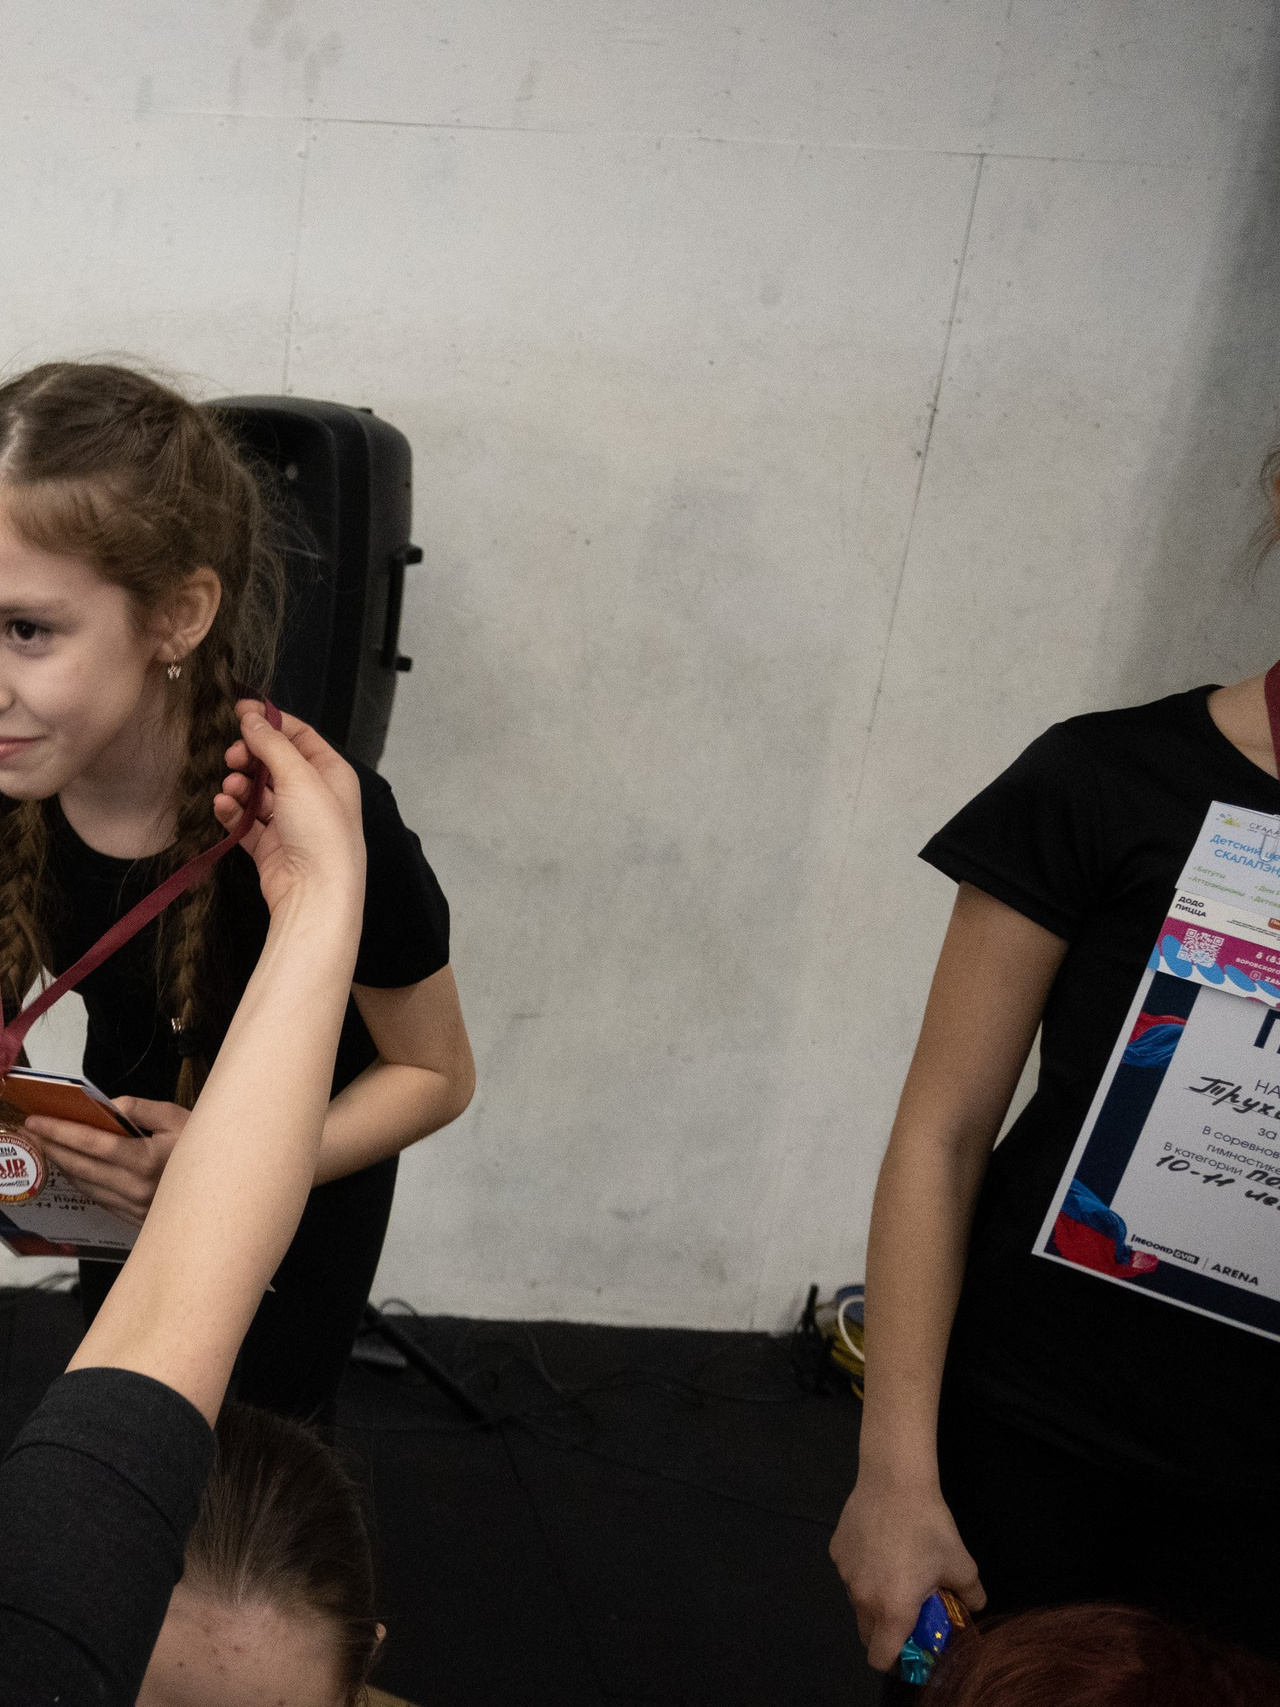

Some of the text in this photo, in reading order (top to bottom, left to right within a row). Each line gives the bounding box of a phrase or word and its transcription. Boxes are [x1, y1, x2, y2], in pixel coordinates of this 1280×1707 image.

[1210, 834, 1280, 863] Детский це
[1214, 849, 1280, 878] СКАЛАЛЭН
[1175, 903, 1206, 917] ПИЦЦА
[1178, 896, 1204, 908] ДОДО
[1202, 1125, 1211, 1136] В
[1258, 1128, 1278, 1140] за
[1163, 1141, 1173, 1151] В
[1174, 1147, 1243, 1176] категории
[1156, 1155, 1236, 1187] 10-11
[1210, 1263, 1259, 1286] ARENA
